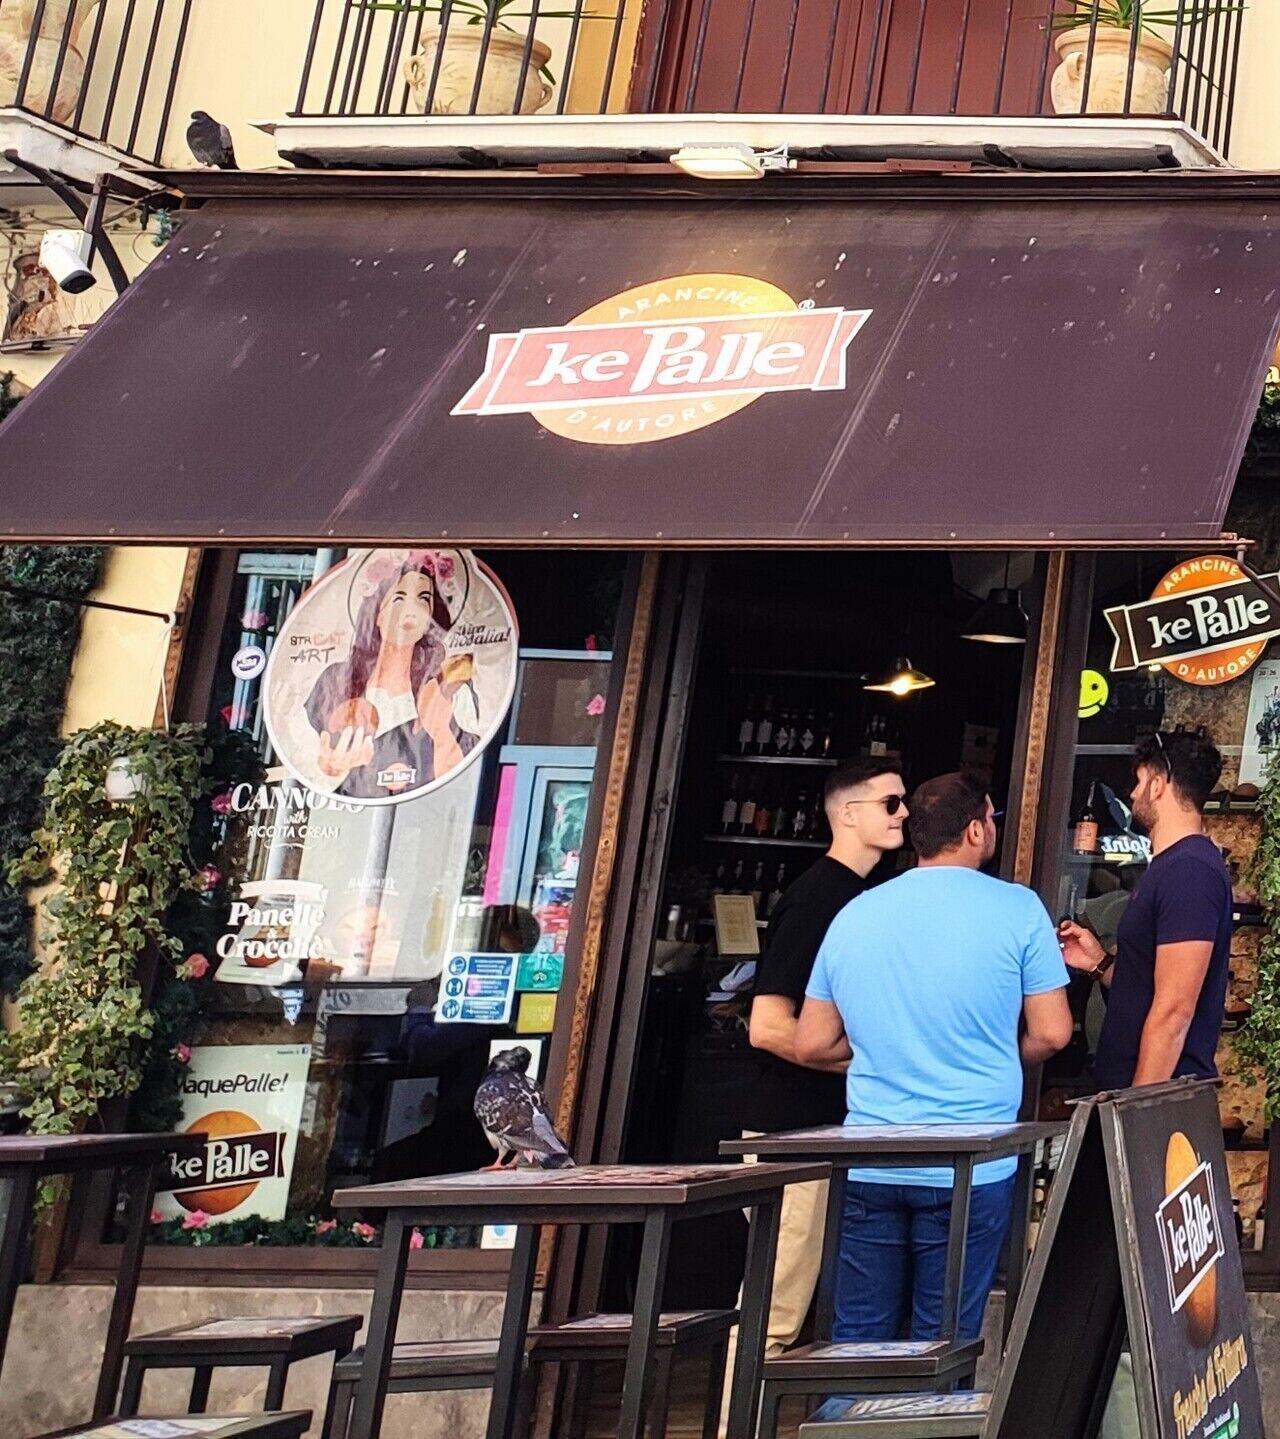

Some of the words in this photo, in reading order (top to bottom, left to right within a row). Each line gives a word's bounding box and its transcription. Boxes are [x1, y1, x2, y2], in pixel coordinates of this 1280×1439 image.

[617, 286, 758, 320] ARANCINE
[565, 400, 718, 433] D'AUTORE
[1163, 559, 1240, 592] ARANCINE
[290, 646, 336, 663] ART
[1177, 647, 1257, 681] D'AUTORE
[231, 783, 364, 813] CANNOL
[247, 826, 295, 838] RICOTTA
[298, 826, 339, 838] CREAM
[227, 901, 325, 927] Panelle
